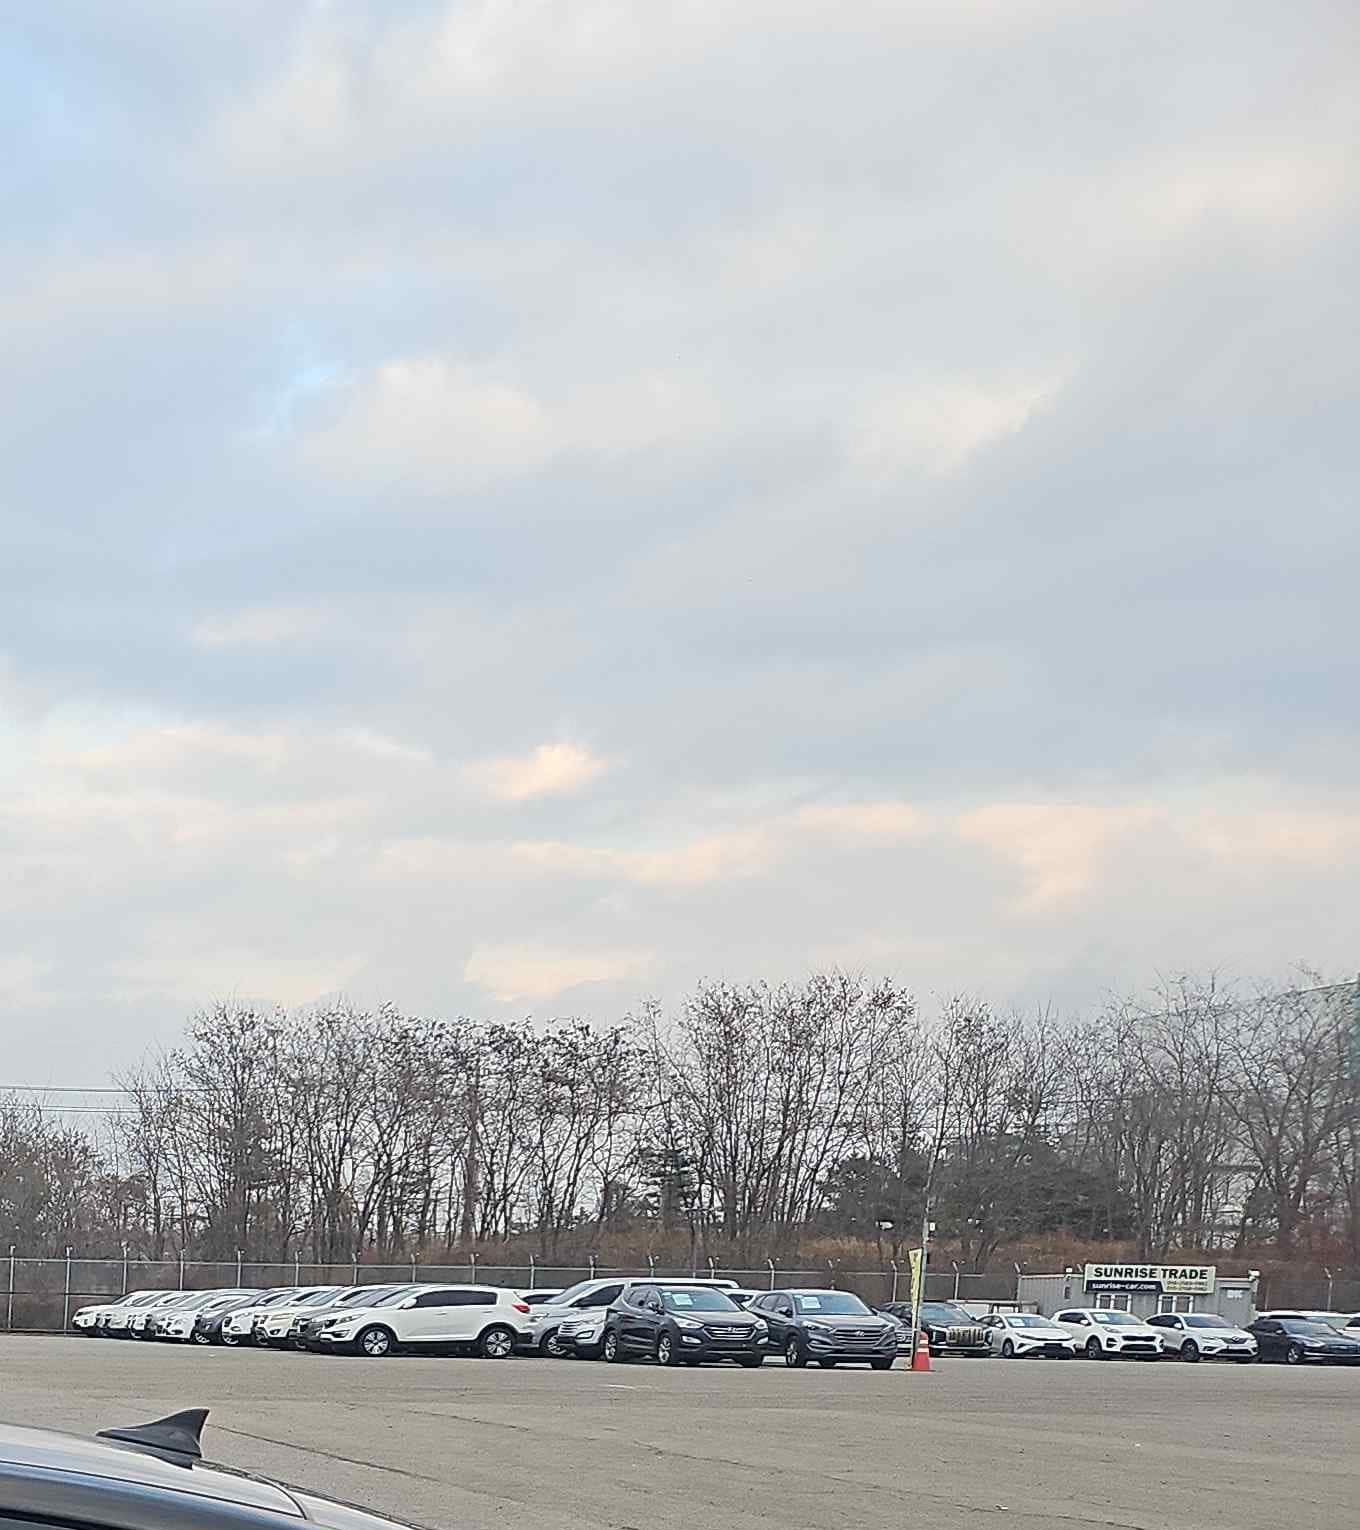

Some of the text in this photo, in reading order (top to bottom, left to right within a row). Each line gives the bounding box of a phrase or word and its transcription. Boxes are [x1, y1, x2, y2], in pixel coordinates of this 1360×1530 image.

[1094, 1267, 1208, 1280] SUNRISE TRADE
[1091, 1281, 1156, 1290] sunrise-car.com
